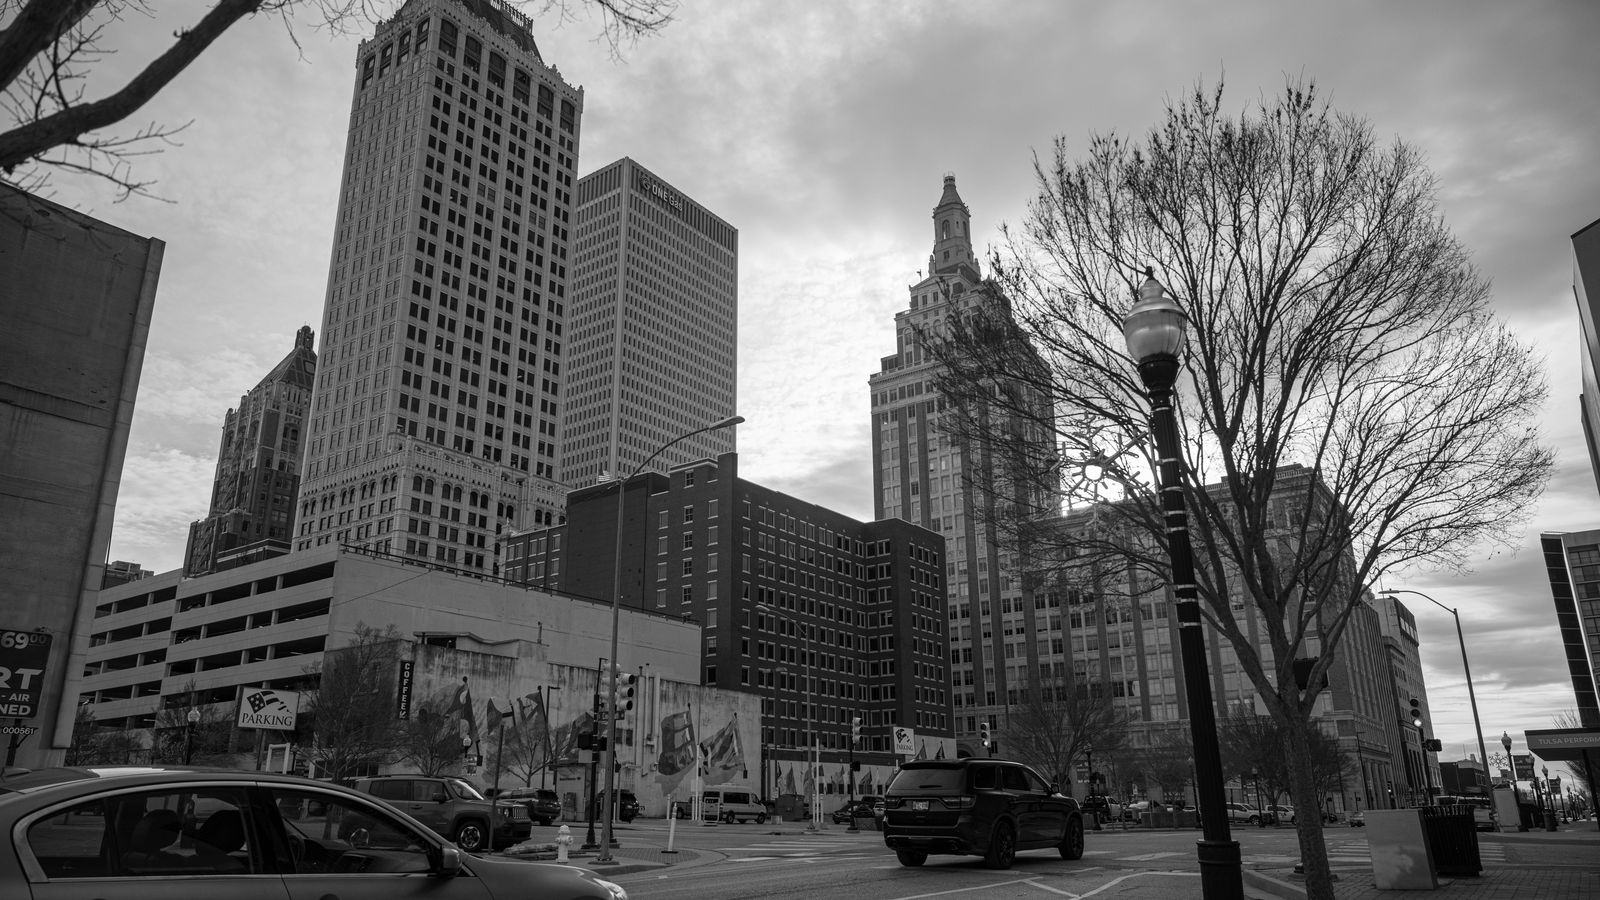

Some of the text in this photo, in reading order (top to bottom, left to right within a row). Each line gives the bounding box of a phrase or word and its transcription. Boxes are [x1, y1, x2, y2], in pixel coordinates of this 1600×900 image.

[652, 184, 668, 202] ONE
[401, 662, 411, 710] COFFEE
[9, 692, 30, 702] AIR
[241, 712, 293, 727] PARKING
